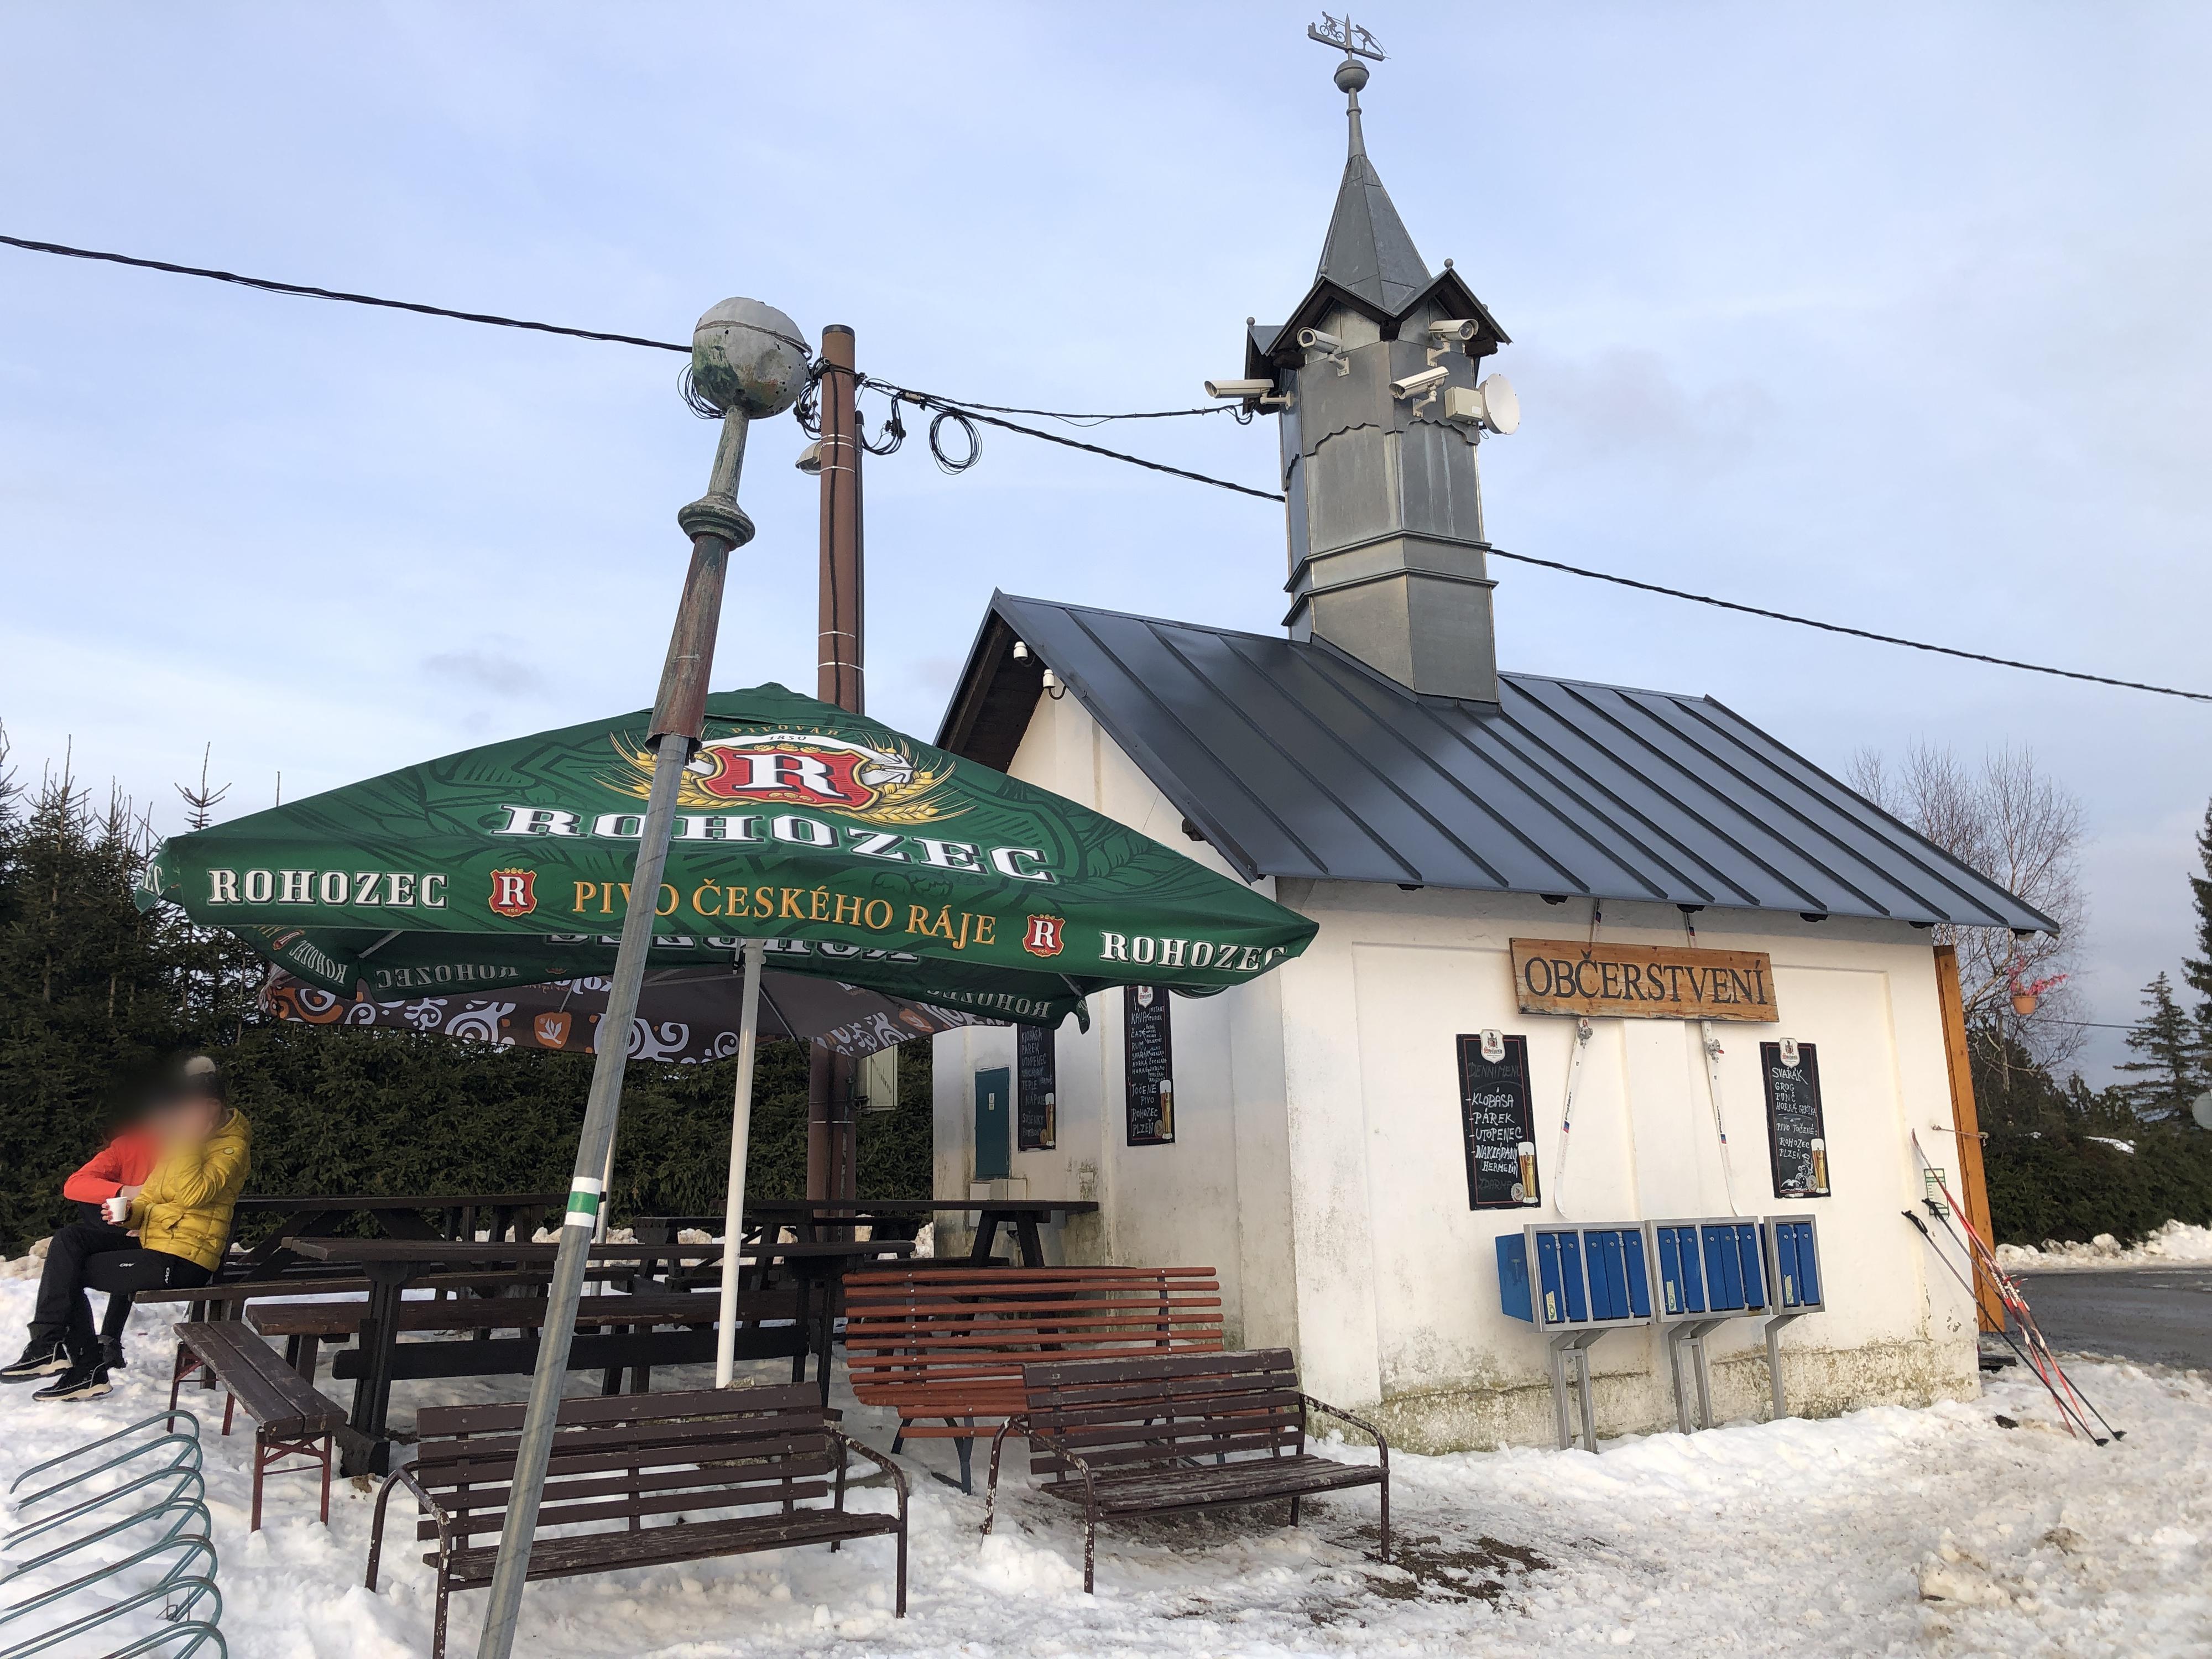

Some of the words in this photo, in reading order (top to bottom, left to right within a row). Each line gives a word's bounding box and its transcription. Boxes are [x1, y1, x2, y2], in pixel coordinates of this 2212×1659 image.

[729, 724, 839, 736] PIVOVAR
[733, 753, 852, 800] R
[491, 805, 1056, 884] ROHOZEC
[207, 869, 448, 909] ROHOZEC
[498, 875, 529, 907] R
[692, 878, 894, 930] ČESKÉHO
[907, 901, 995, 950] RÁJE
[1030, 920, 1057, 949] R
[1524, 949, 1767, 1005] OBČERSTVENÍ
